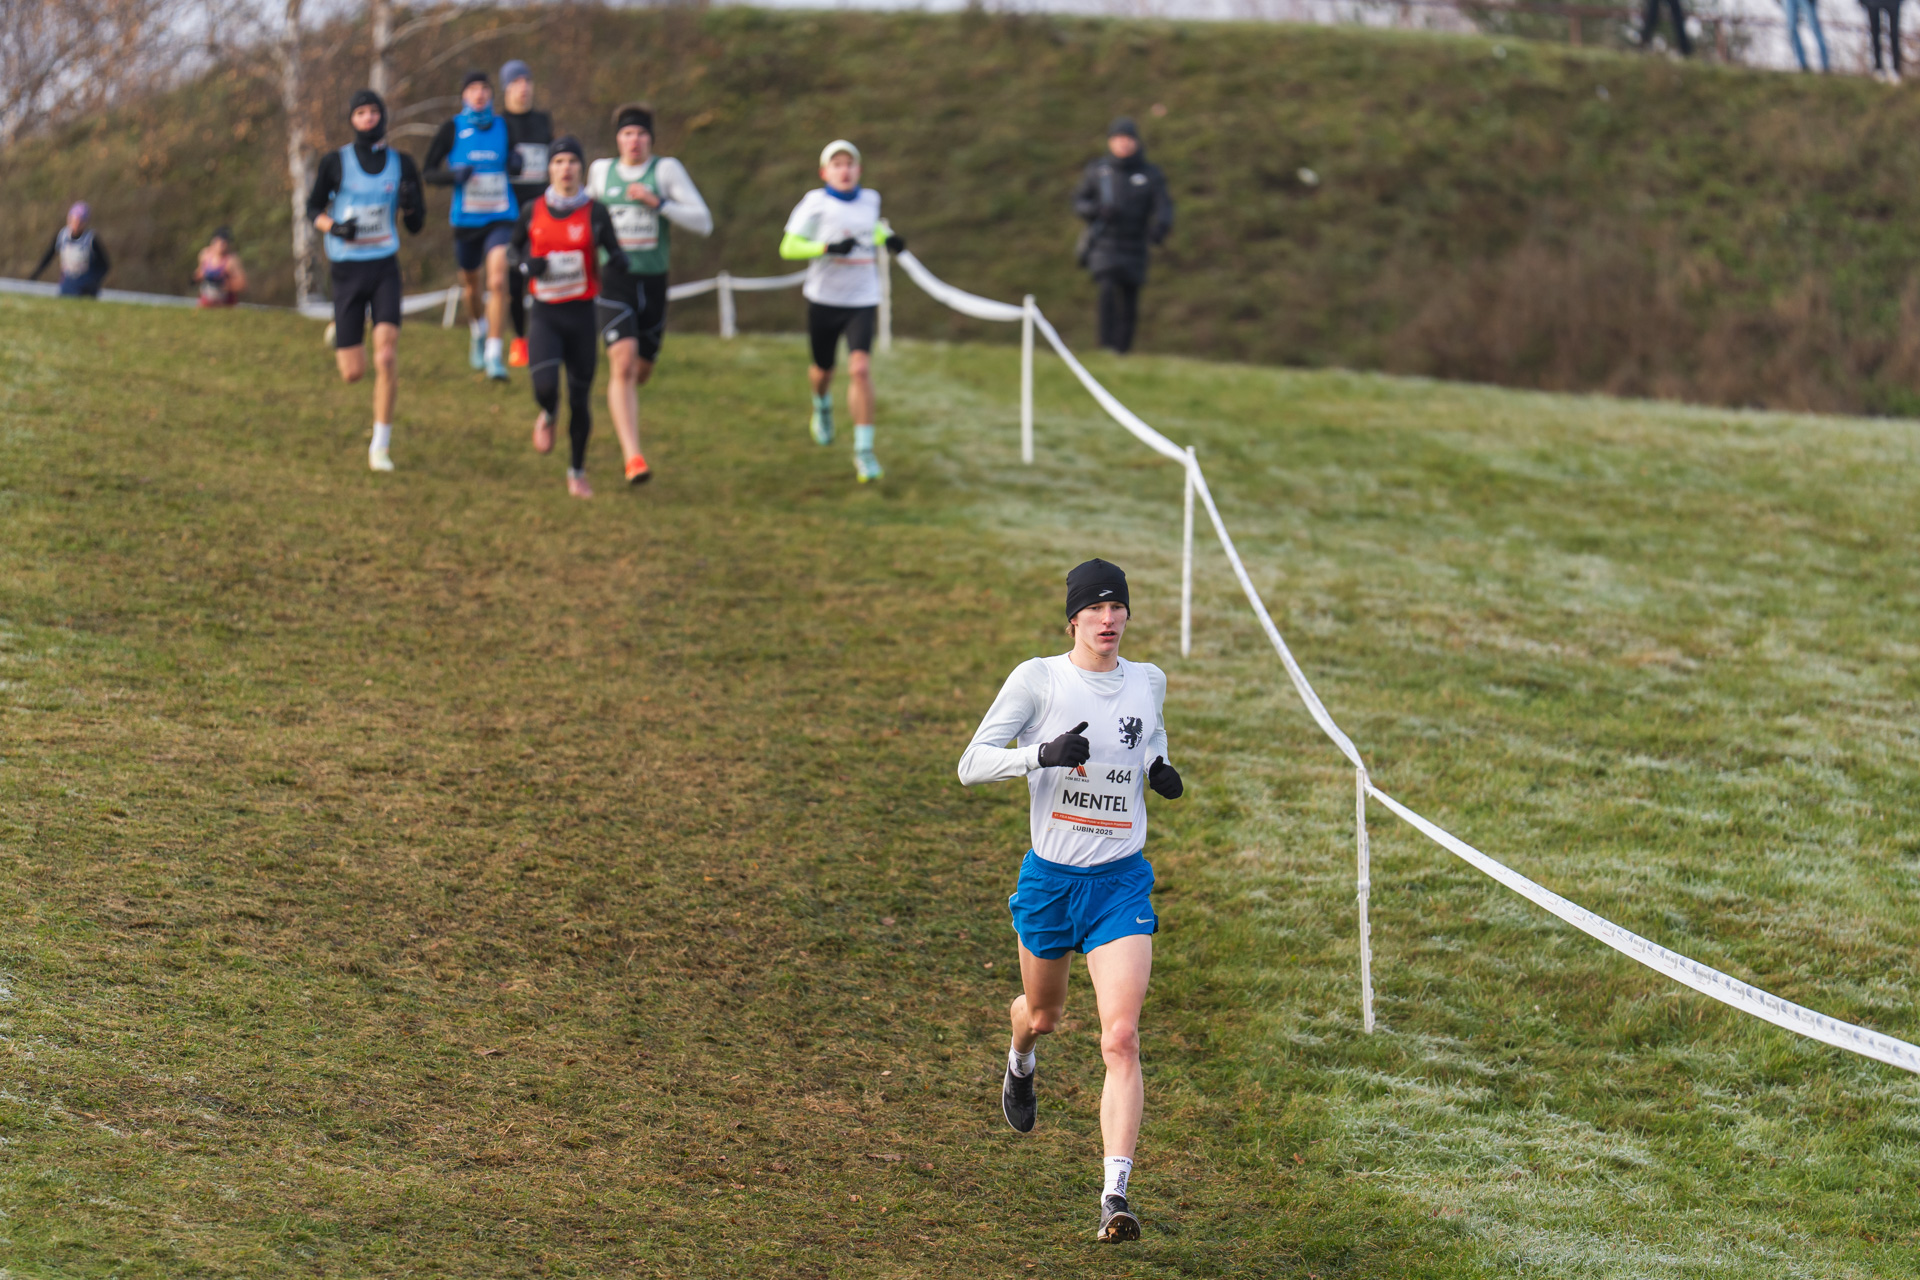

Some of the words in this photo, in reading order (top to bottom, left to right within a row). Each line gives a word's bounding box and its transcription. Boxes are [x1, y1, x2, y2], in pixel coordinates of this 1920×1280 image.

[1106, 769, 1131, 784] 464
[1062, 789, 1128, 812] MENTEL
[1073, 825, 1094, 833] LUBIN
[1095, 828, 1113, 836] 2025
